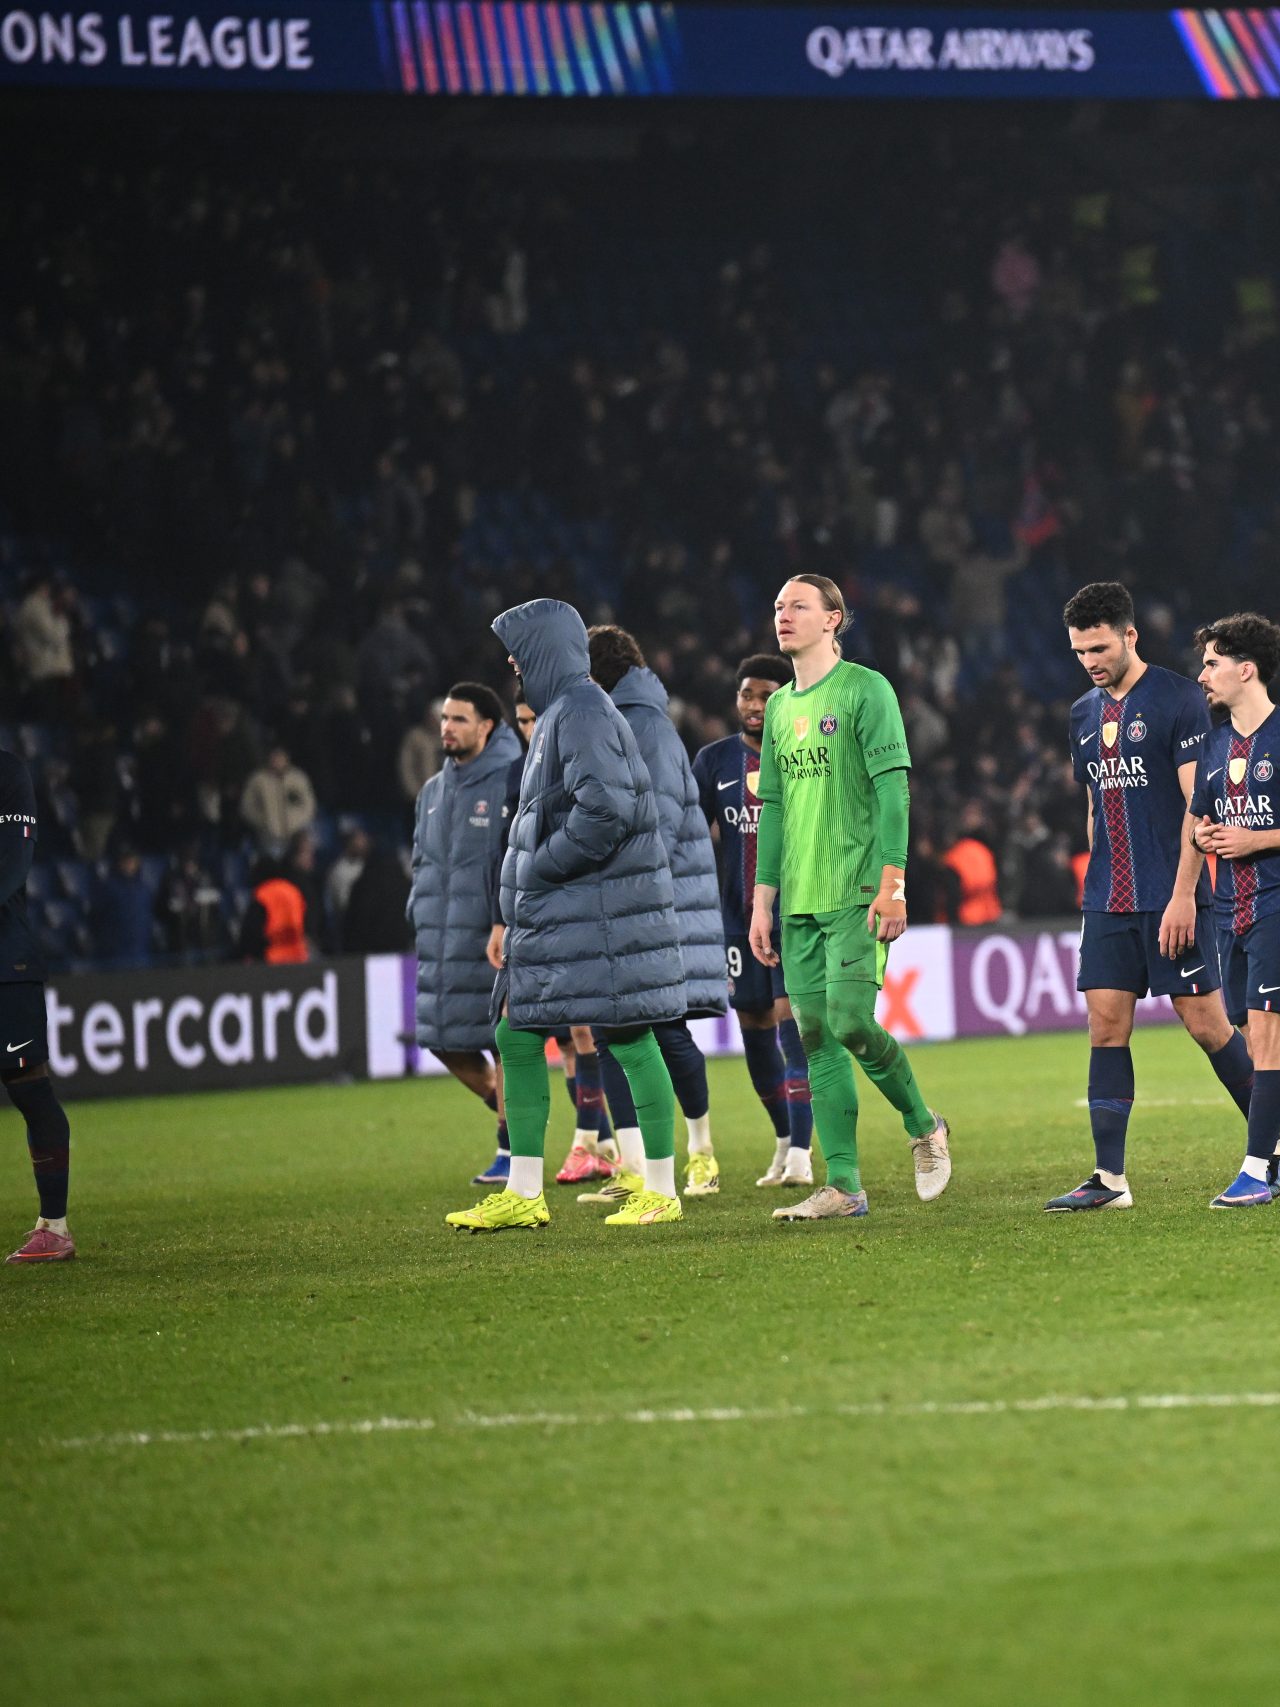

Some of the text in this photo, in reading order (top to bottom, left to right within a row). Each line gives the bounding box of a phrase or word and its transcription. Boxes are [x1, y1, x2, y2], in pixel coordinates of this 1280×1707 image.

[118, 15, 313, 69] LEAGUE
[806, 26, 1095, 77] QATAR AIRWAYS
[780, 746, 830, 773] QATAR
[1087, 756, 1147, 782] QATAR
[1099, 775, 1149, 790] AIRWAYS
[724, 805, 763, 827] QAT
[1215, 795, 1273, 820] QATAR
[1225, 814, 1274, 827] AIRWAYS
[738, 822, 759, 834] AIR
[726, 945, 743, 978] 9
[46, 969, 340, 1078] tercard
